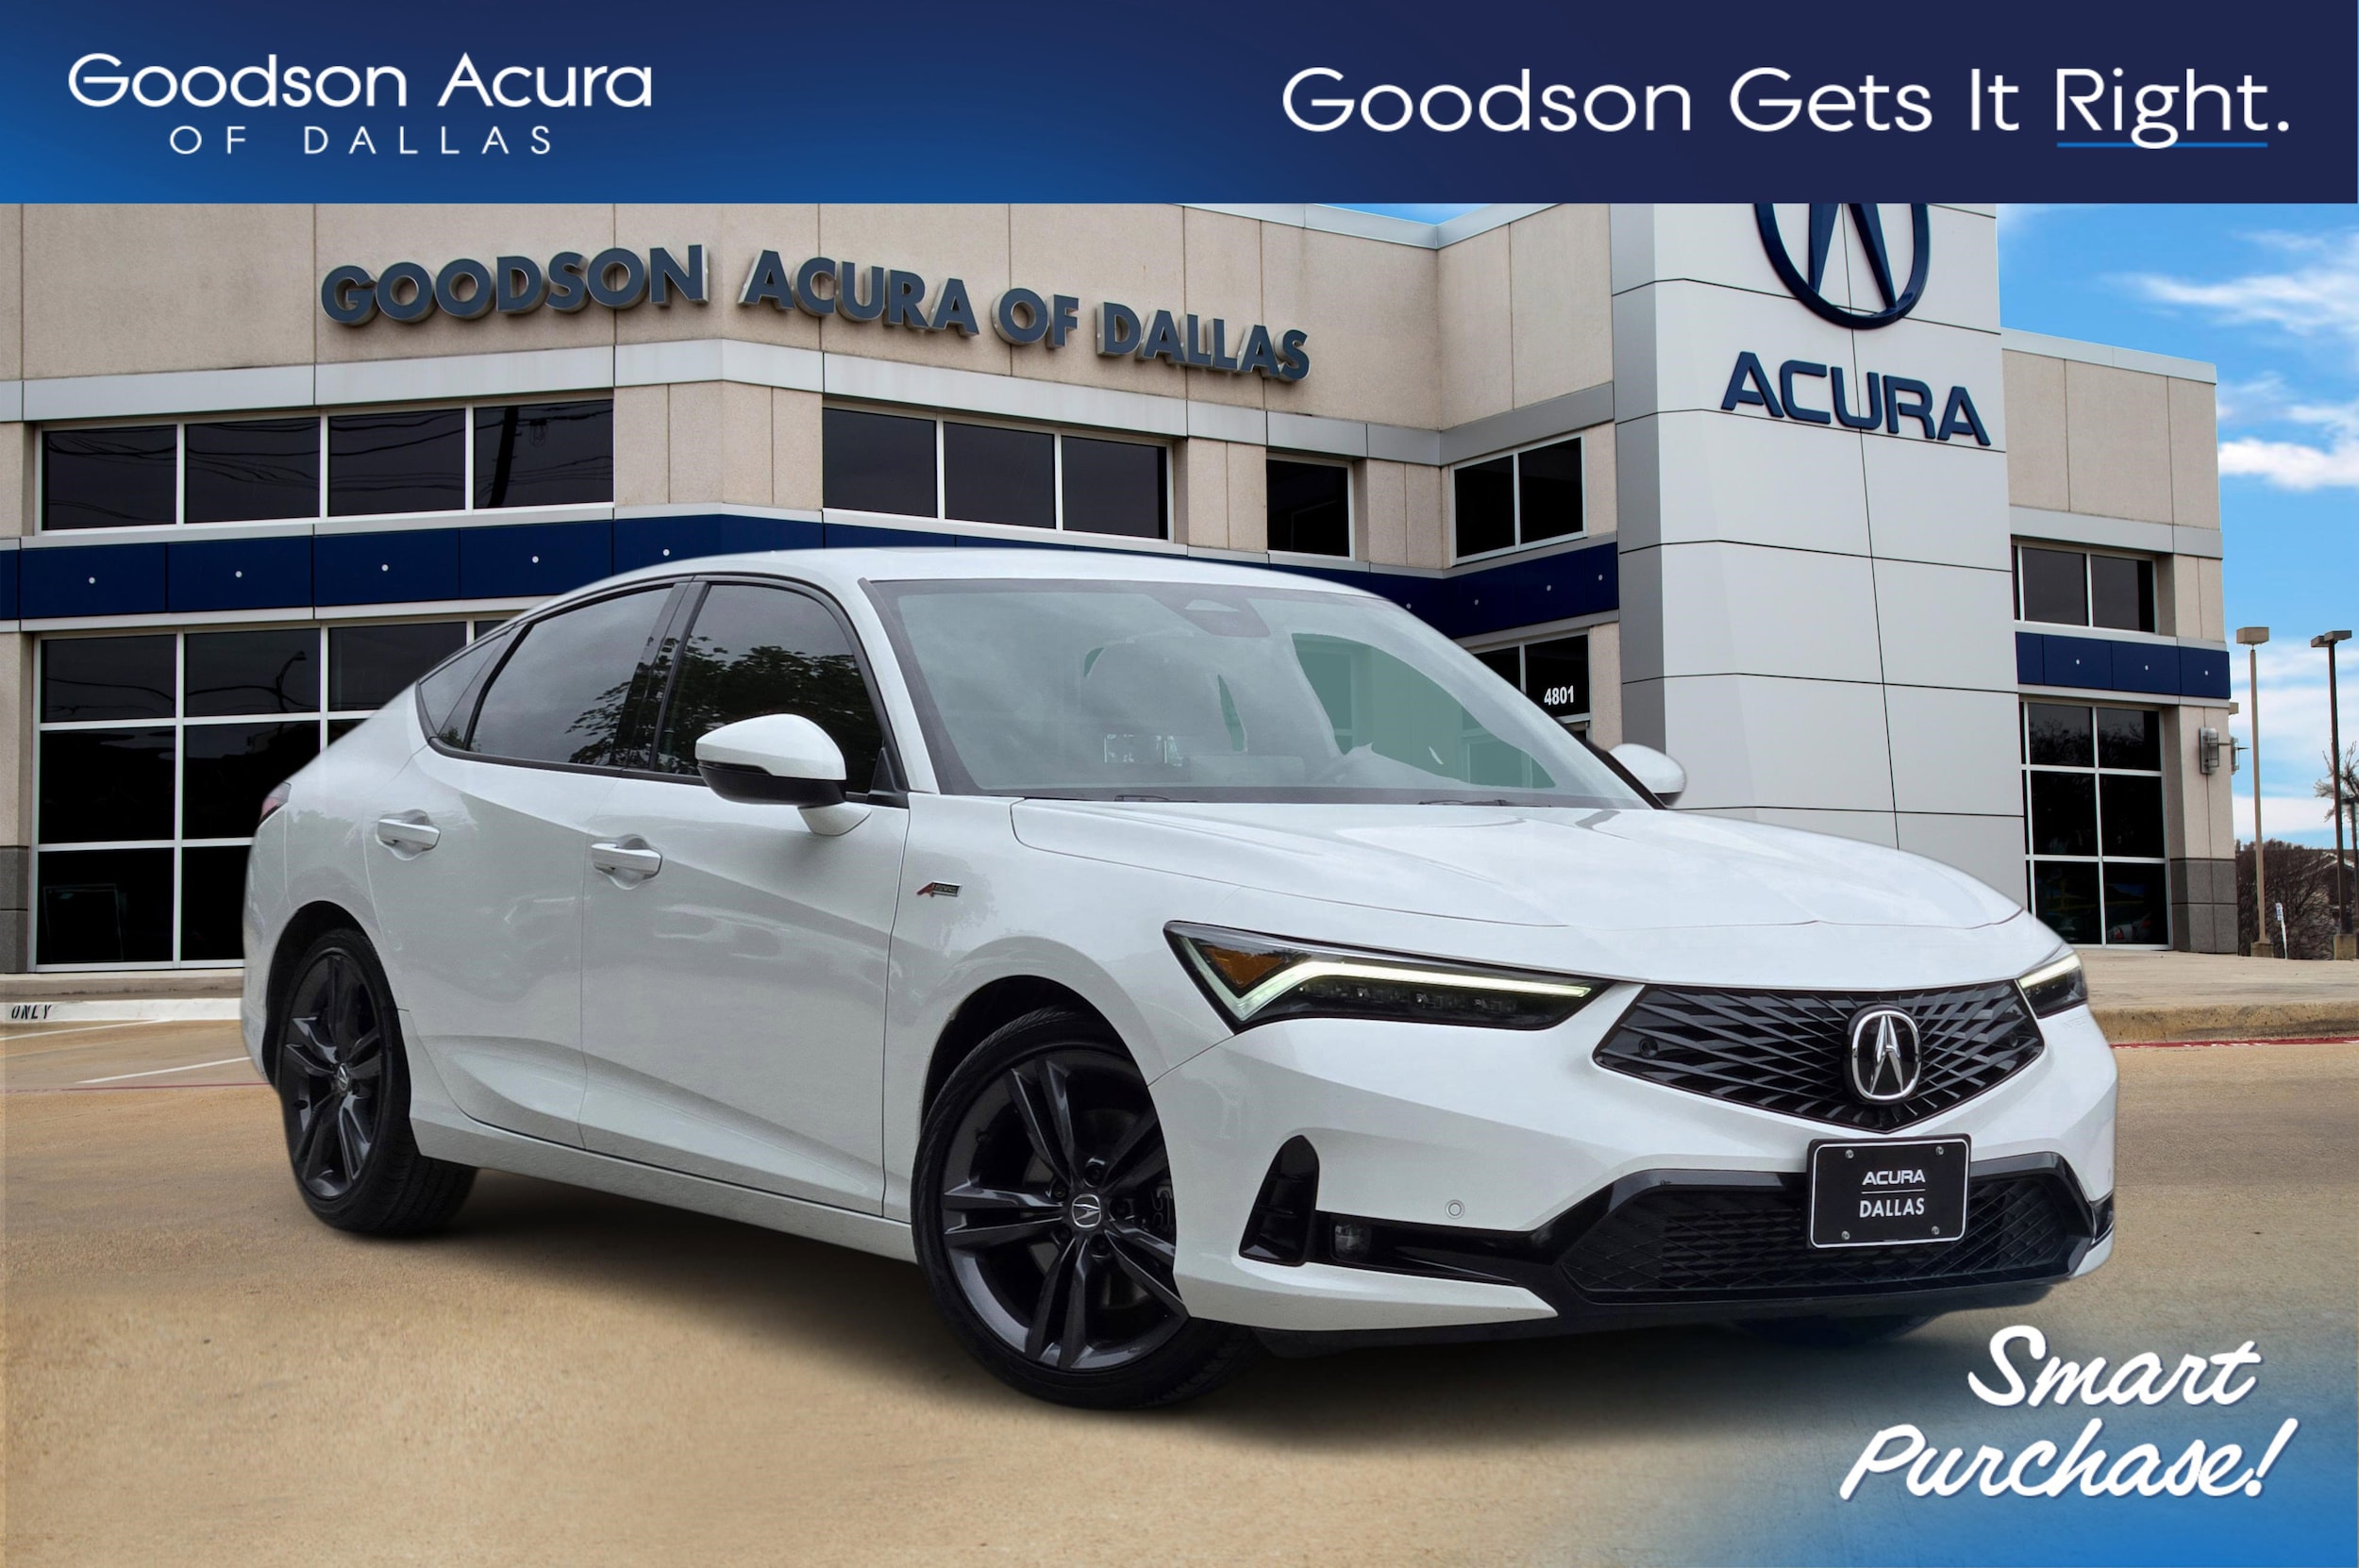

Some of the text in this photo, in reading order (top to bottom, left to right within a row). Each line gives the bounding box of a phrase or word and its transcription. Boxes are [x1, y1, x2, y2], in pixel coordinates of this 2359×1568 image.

[321, 243, 1311, 381] GOODSON ACURA OF DALLAS
[1720, 350, 1991, 446] ACURA
[1544, 685, 1575, 706] 4801
[11, 1004, 52, 1020] ONLY
[1862, 1169, 1926, 1186] ACURA
[1859, 1197, 1925, 1218] DALLAS
